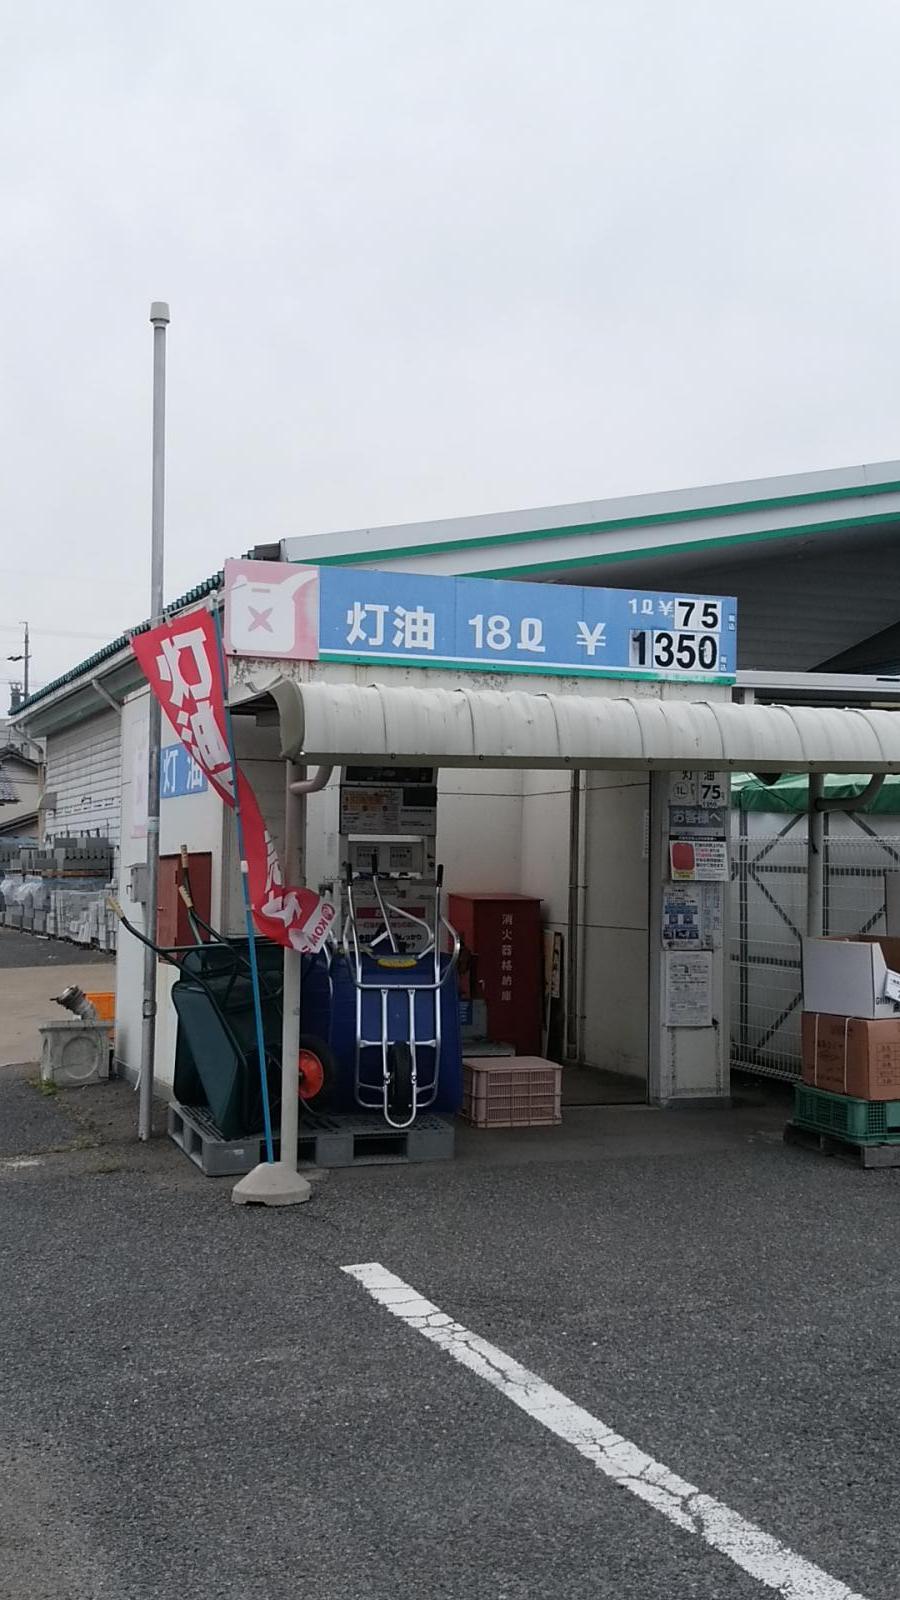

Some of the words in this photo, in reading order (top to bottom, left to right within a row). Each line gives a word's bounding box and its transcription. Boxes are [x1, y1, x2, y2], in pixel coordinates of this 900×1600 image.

[346, 601, 435, 650] 灯油
[632, 631, 718, 669] 1350
[678, 601, 718, 629] 75
[156, 627, 231, 770] 灯油
[162, 750, 203, 792] 灯油
[701, 784, 721, 800] 75
